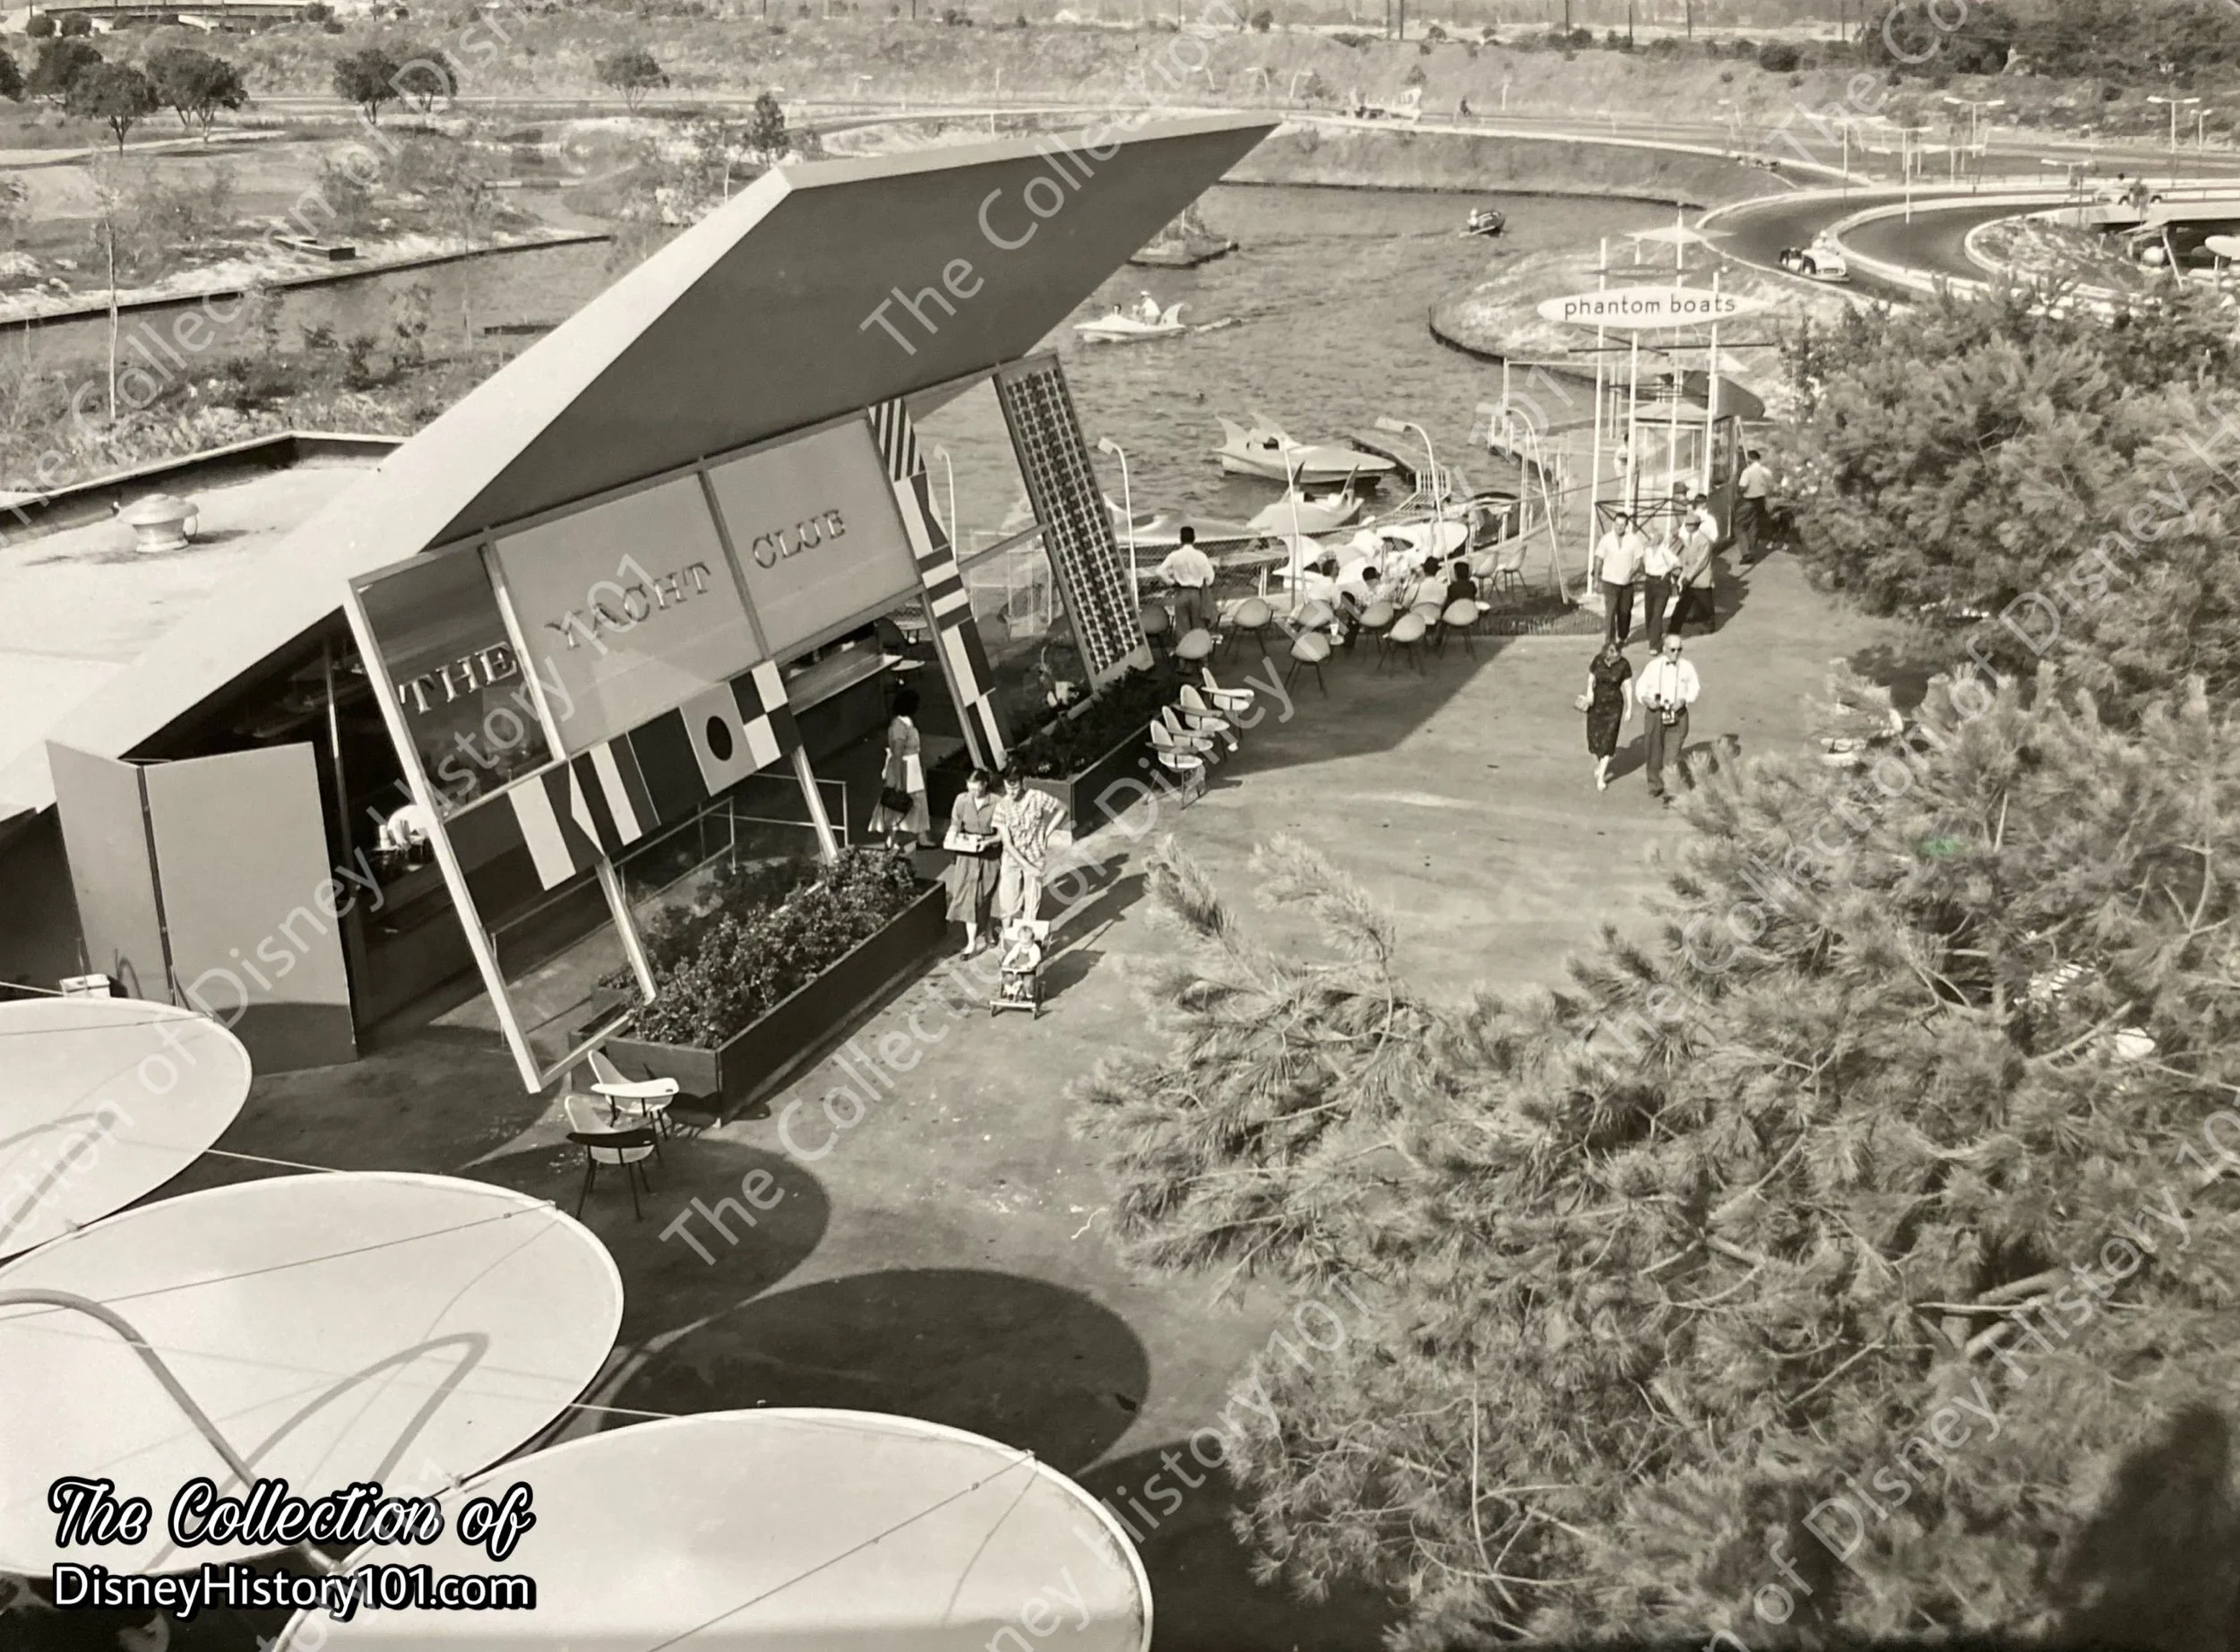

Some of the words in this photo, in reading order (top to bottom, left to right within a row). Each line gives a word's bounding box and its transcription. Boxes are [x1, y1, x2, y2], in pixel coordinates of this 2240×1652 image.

[1564, 295, 1660, 320] phantom
[1670, 293, 1736, 314] boats
[399, 641, 517, 715] THE
[544, 561, 711, 650] YACHT
[752, 509, 846, 569] CLUB
